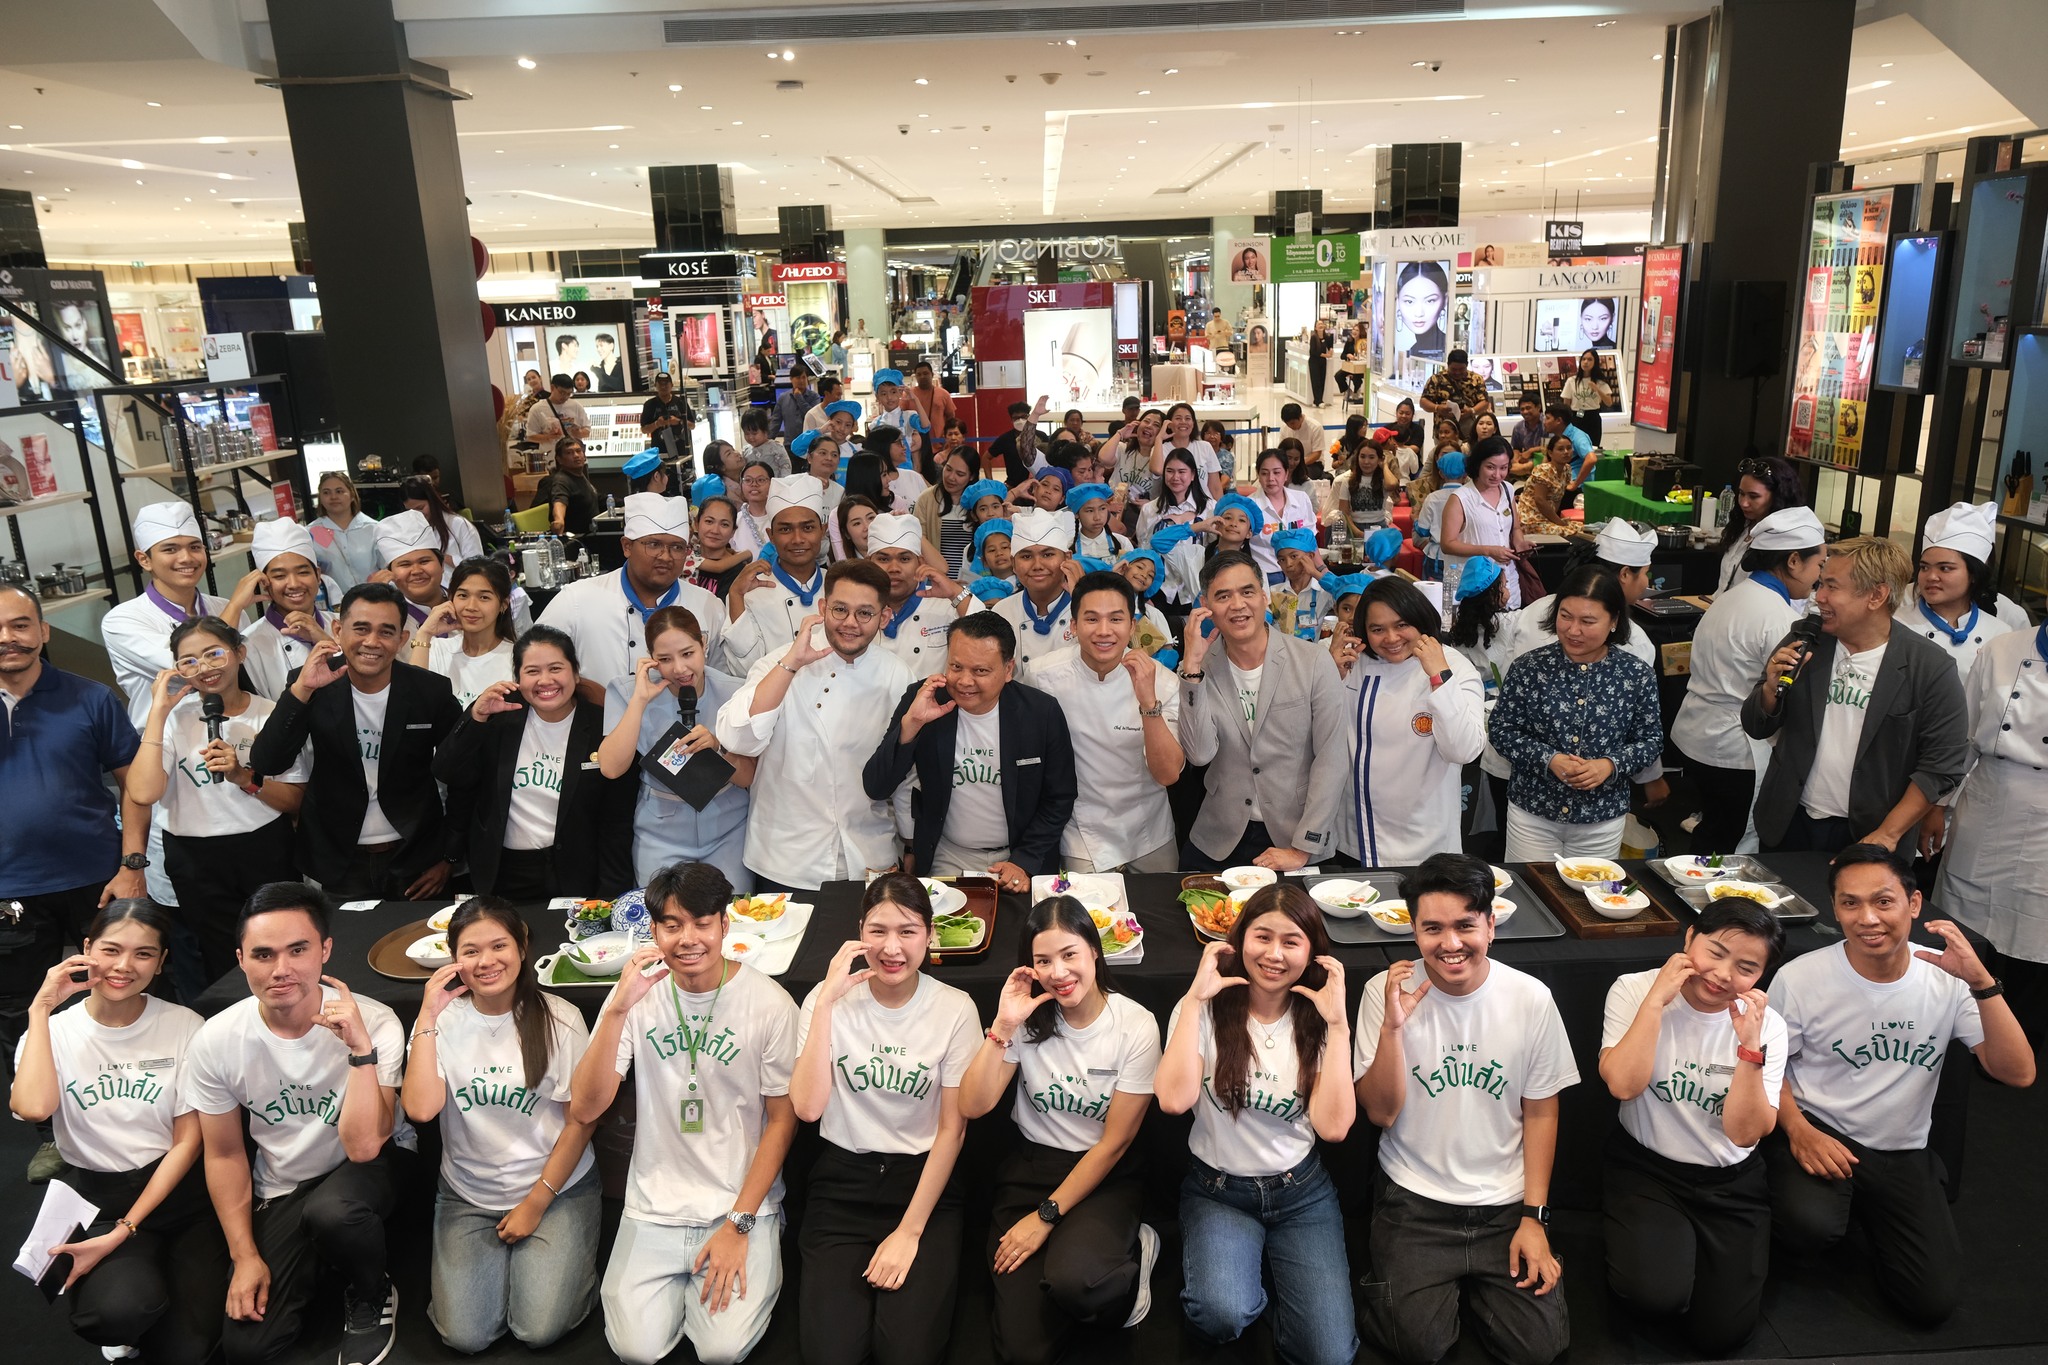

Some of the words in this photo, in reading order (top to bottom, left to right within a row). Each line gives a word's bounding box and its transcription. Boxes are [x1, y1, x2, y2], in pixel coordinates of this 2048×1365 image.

[1550, 224, 1582, 238] KIS
[1391, 232, 1466, 248] LANCÔME
[1550, 239, 1567, 251] BEAUTY
[1567, 238, 1582, 251] STORE
[1336, 249, 1346, 258] 10
[668, 258, 709, 276] KOSÉ
[778, 266, 833, 279] SHISEIDO
[1538, 268, 1621, 287] LANCÔME
[1028, 289, 1057, 304] SK-II
[504, 306, 576, 322] KANEBO
[219, 344, 242, 353] ZEBRA
[1118, 343, 1138, 354] SK-II
[123, 400, 144, 442] 1
[146, 432, 161, 442] FL
[963, 747, 966, 755] I
[1872, 1021, 1875, 1030] I
[871, 1043, 875, 1052] I
[1832, 1034, 1944, 1072] โรบินสัน
[837, 1055, 933, 1100] โรบินสัน
[1412, 1056, 1512, 1100] โรบินสัน
[66, 1071, 164, 1111] โรบินสัน
